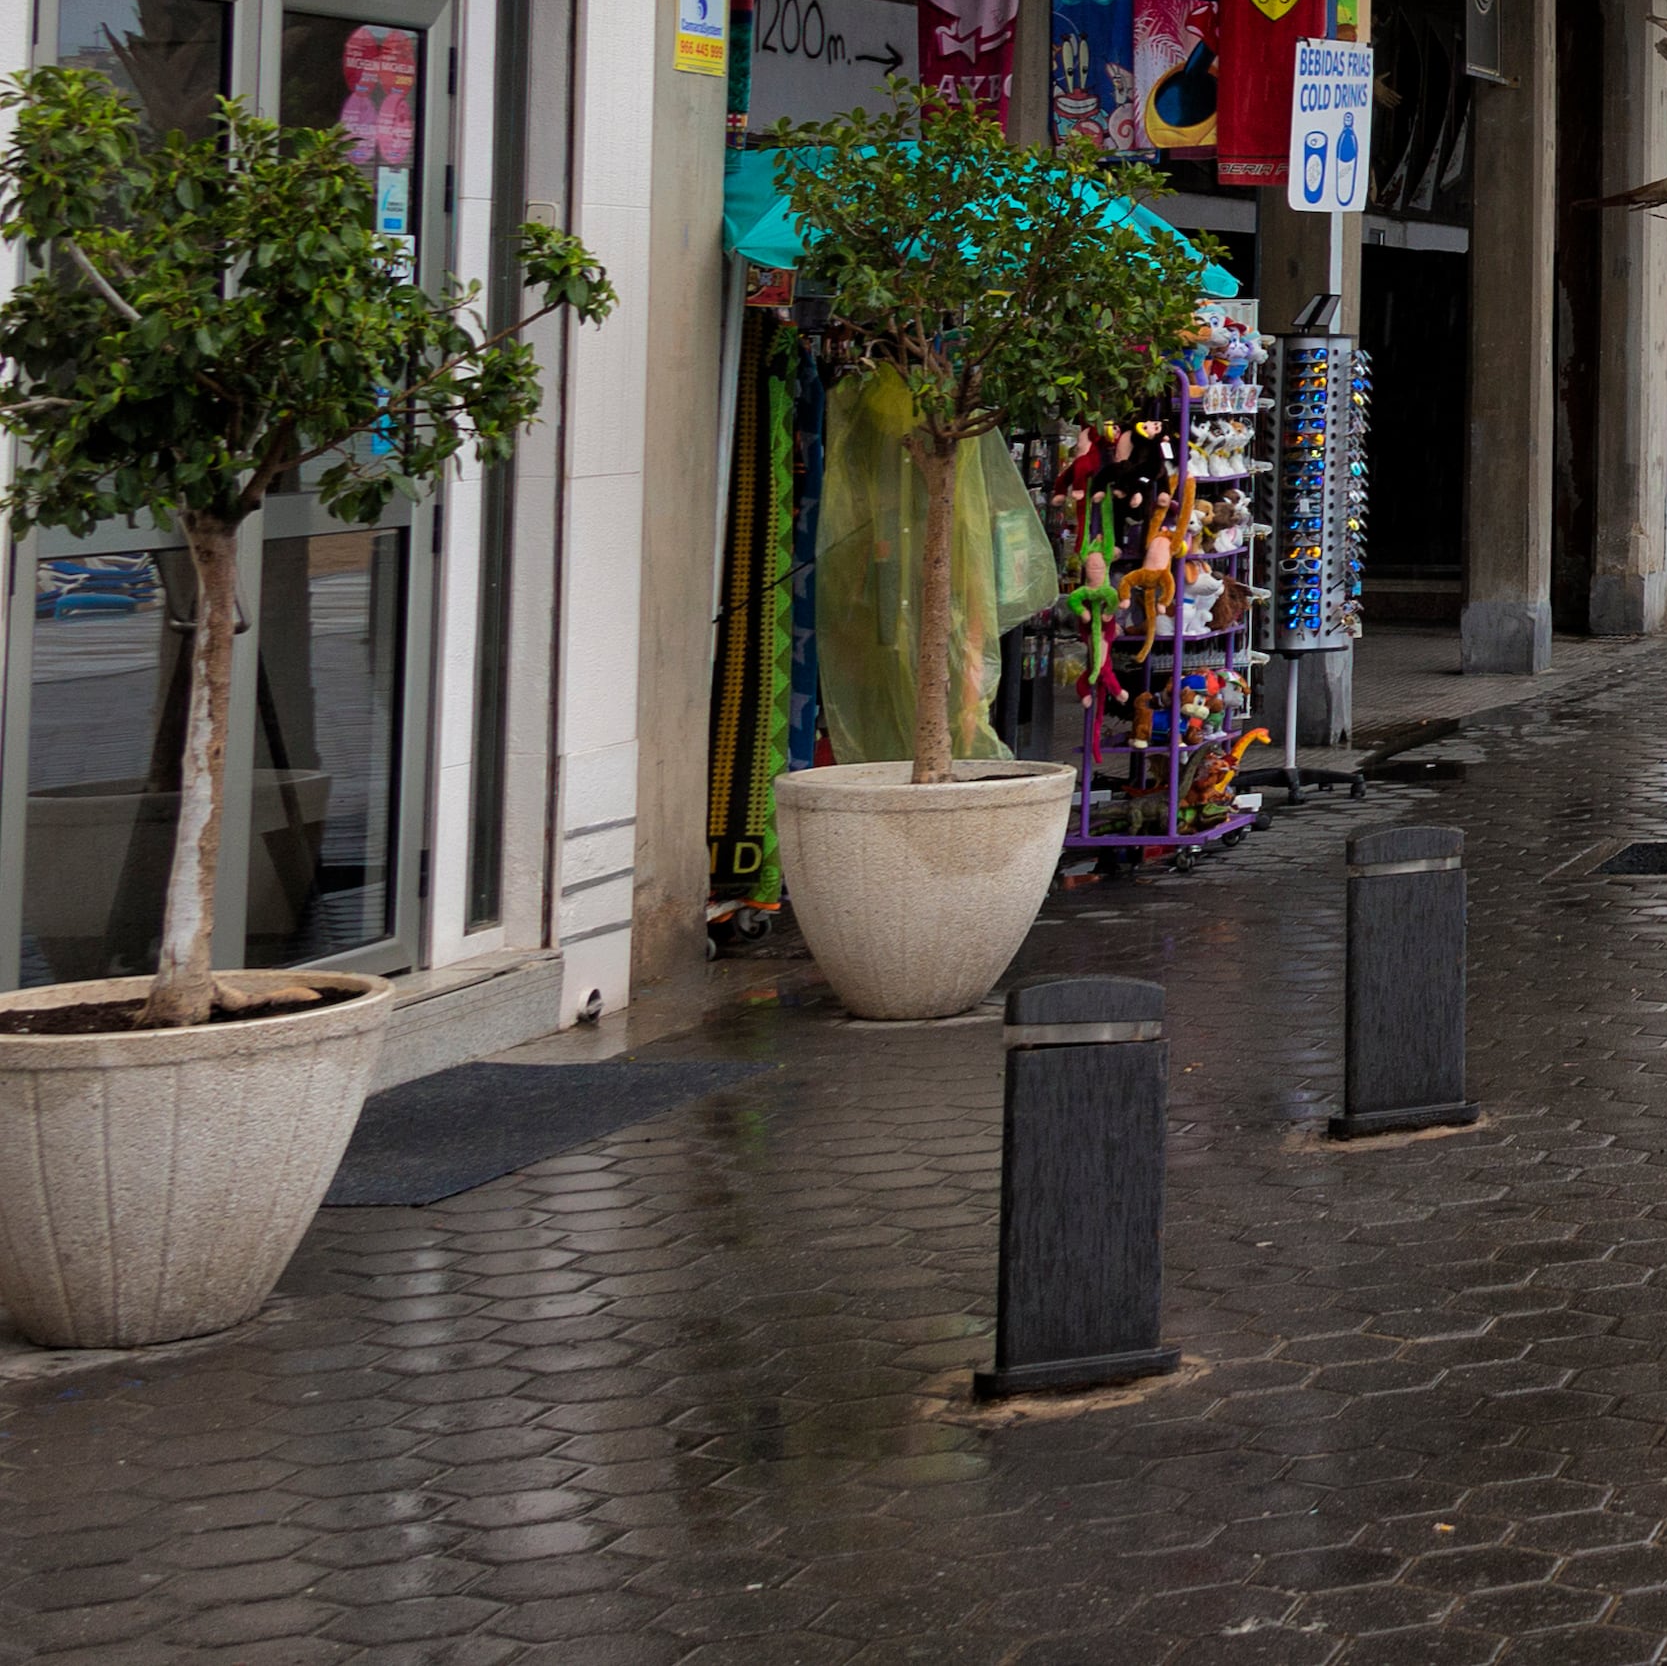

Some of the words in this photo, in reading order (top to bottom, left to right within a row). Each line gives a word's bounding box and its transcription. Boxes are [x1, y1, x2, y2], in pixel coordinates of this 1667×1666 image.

[1299, 48, 1345, 77] BEBIDAS
[1347, 51, 1371, 78] FRIAS
[1299, 83, 1331, 113] COLD
[1333, 83, 1368, 111] DRINKS
